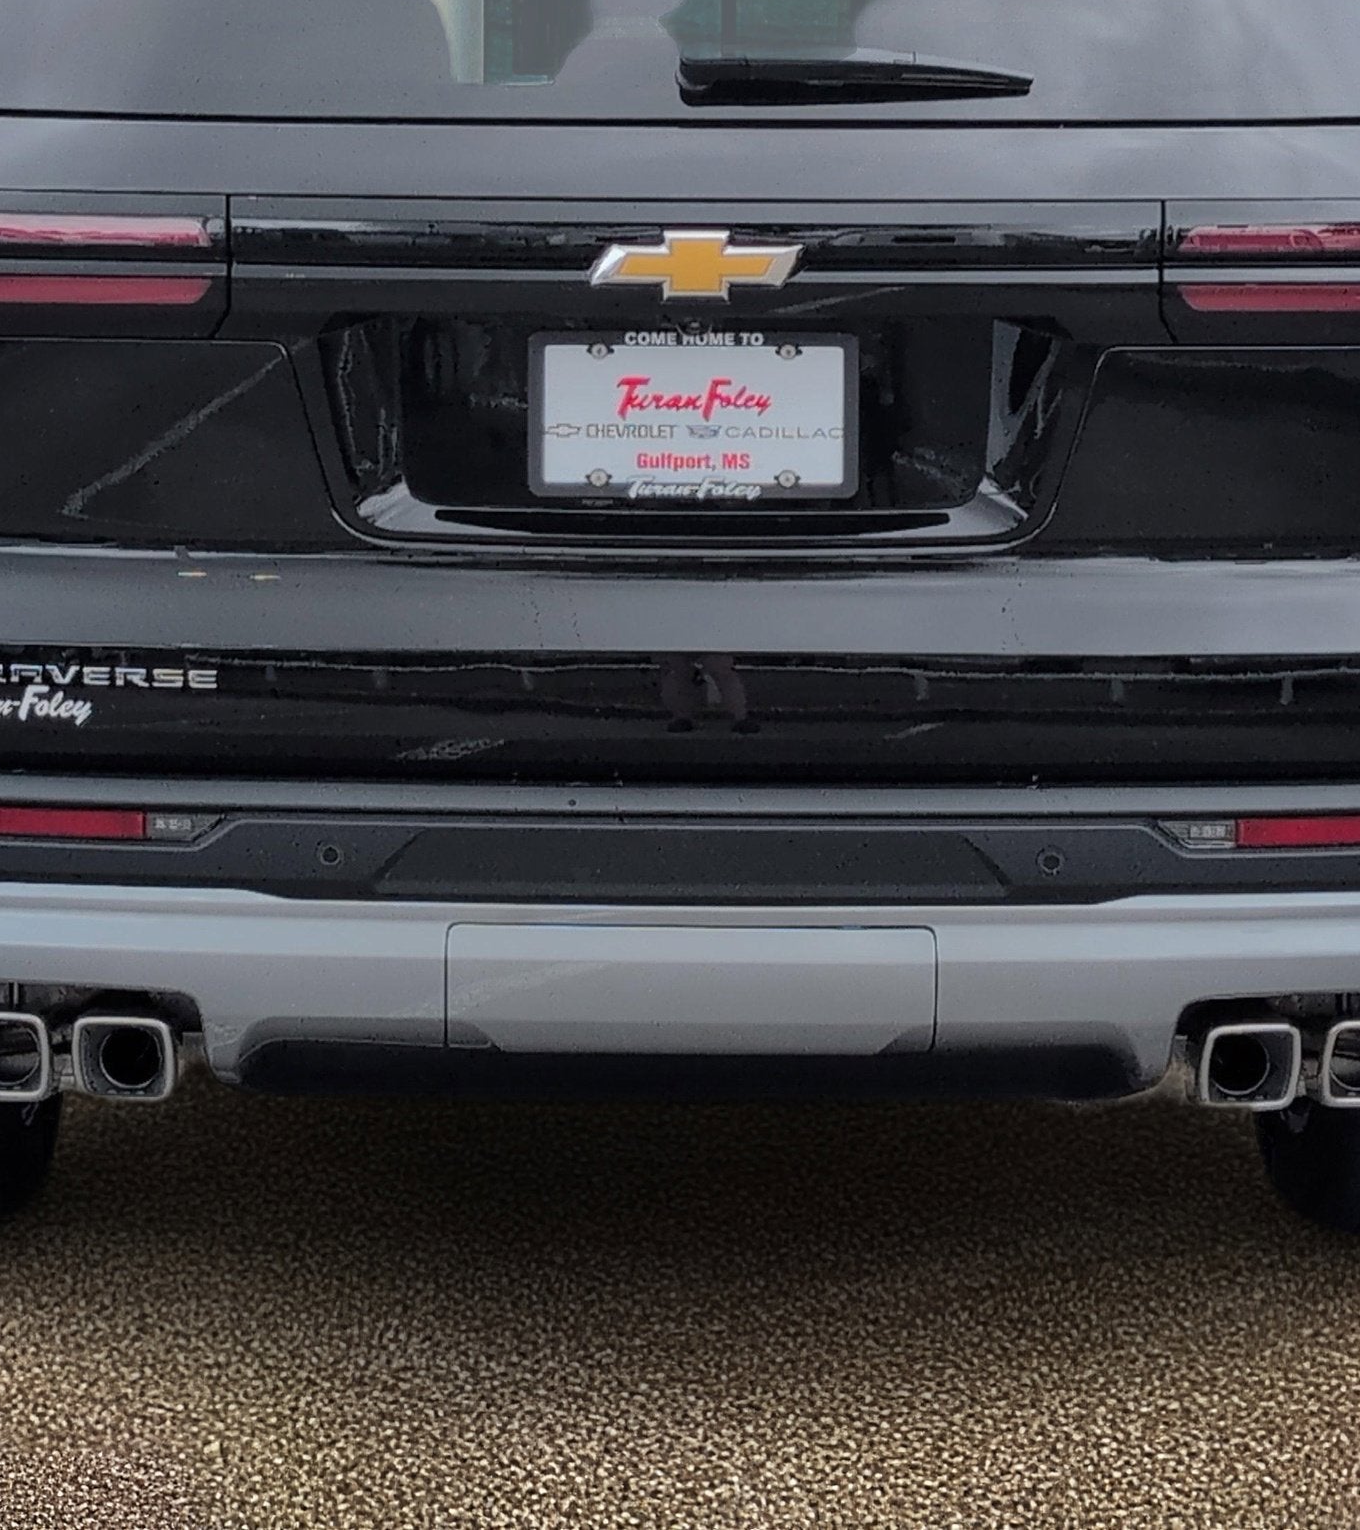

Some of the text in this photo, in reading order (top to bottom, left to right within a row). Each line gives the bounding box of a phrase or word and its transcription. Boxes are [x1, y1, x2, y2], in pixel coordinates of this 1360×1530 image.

[624, 331, 765, 346] COME HOME TO
[586, 423, 844, 440] CHEVROLET CADILLAC
[636, 453, 750, 471] Gulfport, MS
